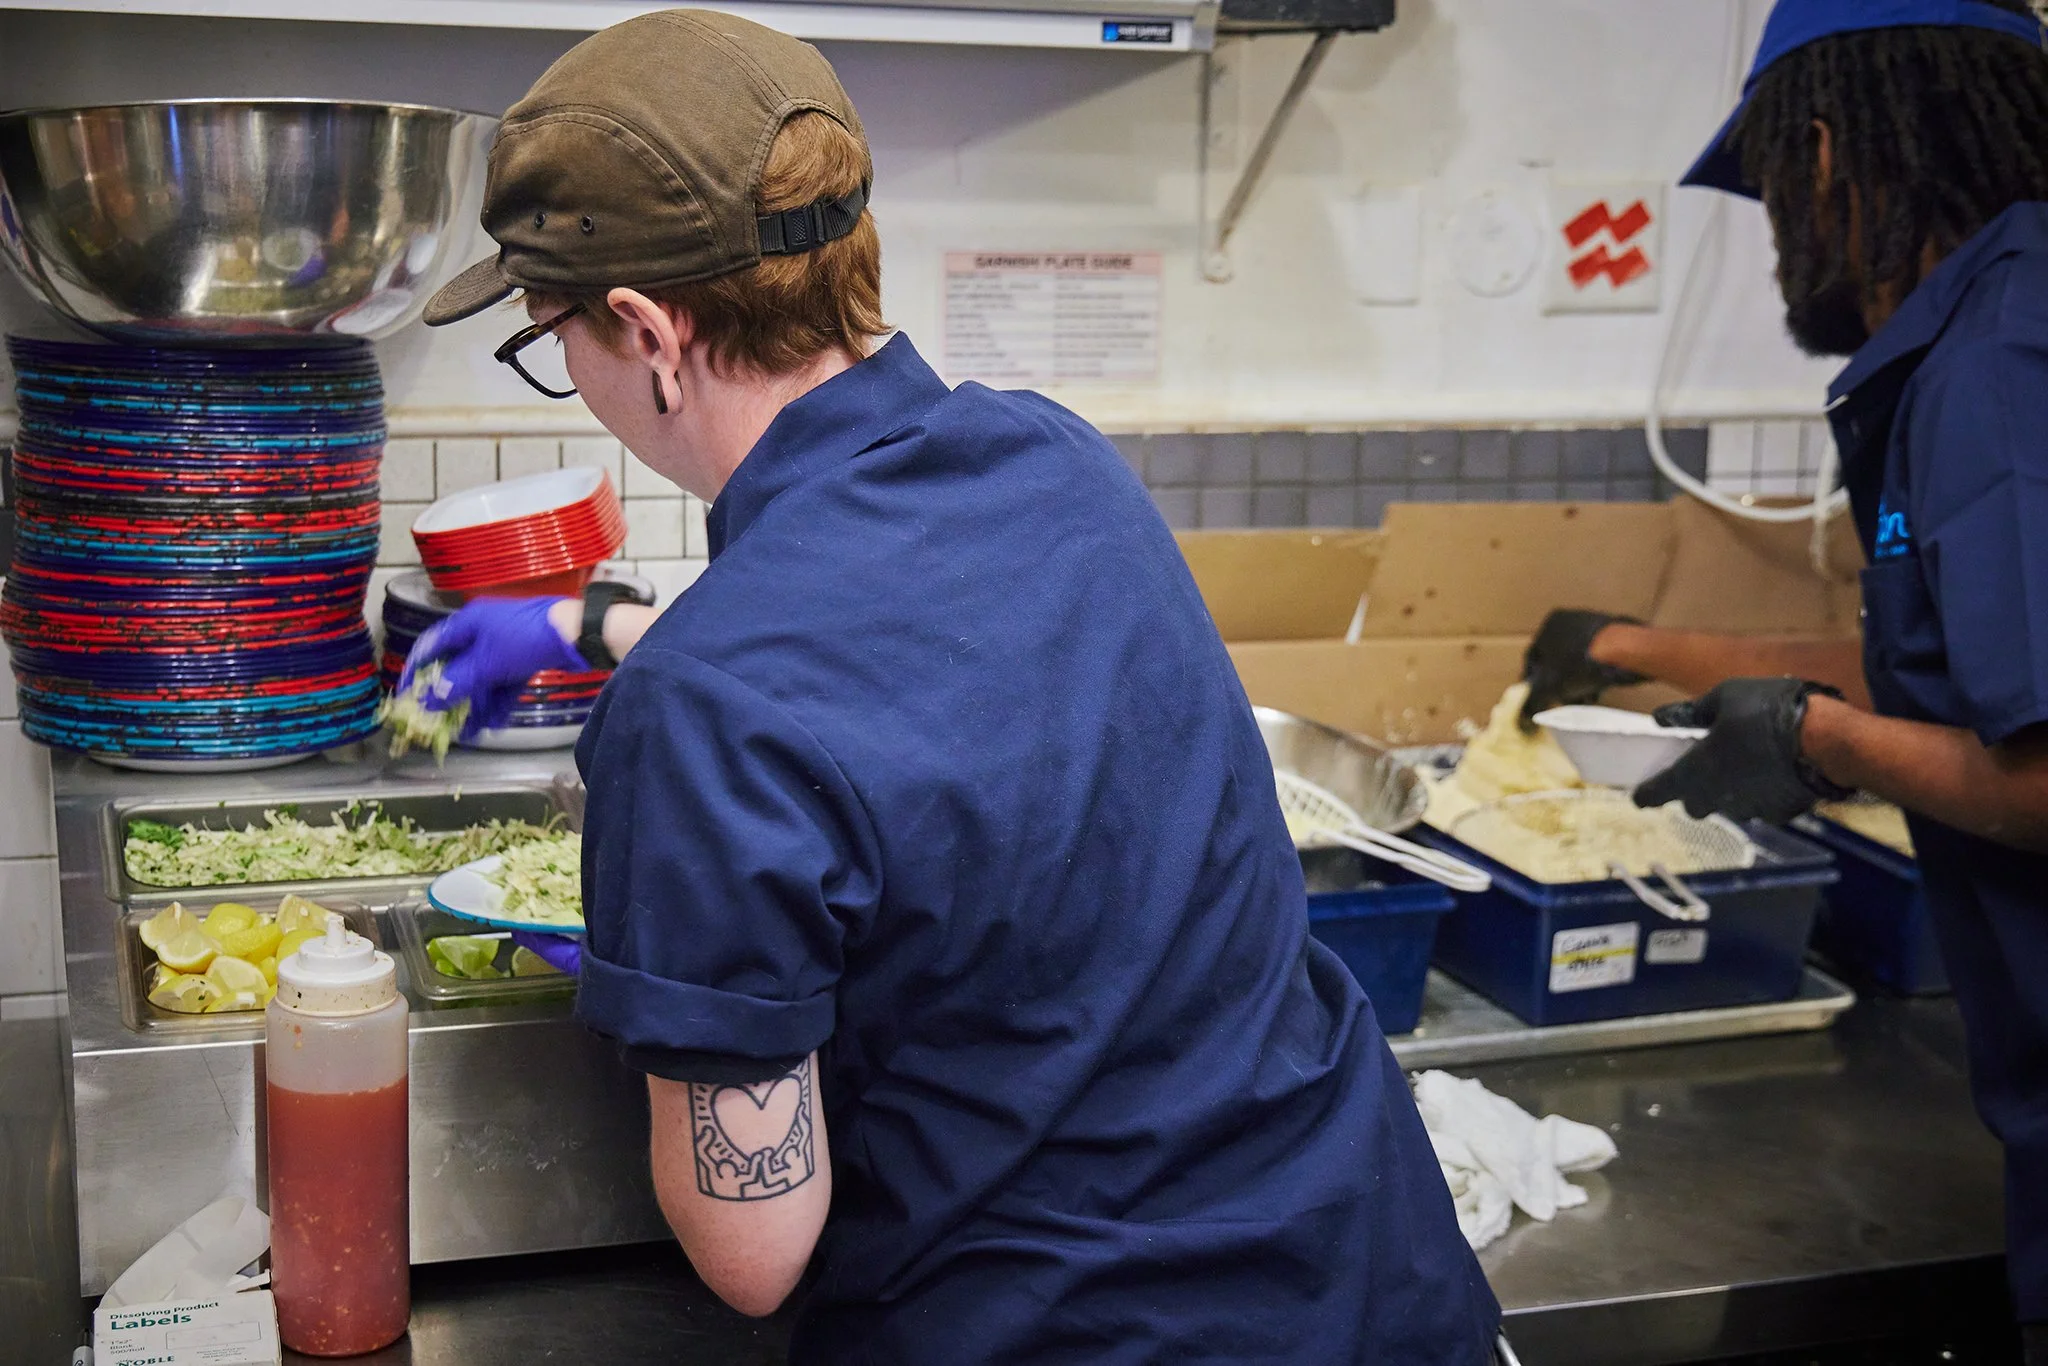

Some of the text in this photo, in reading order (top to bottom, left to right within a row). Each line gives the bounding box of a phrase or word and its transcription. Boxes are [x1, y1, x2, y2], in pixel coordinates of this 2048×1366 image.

[1045, 256, 1086, 269] PLATE
[1092, 256, 1133, 269] GUIDE
[110, 1301, 219, 1320] Dissolving Product
[111, 1313, 192, 1331] Labels
[118, 1355, 175, 1366] NOBLE
